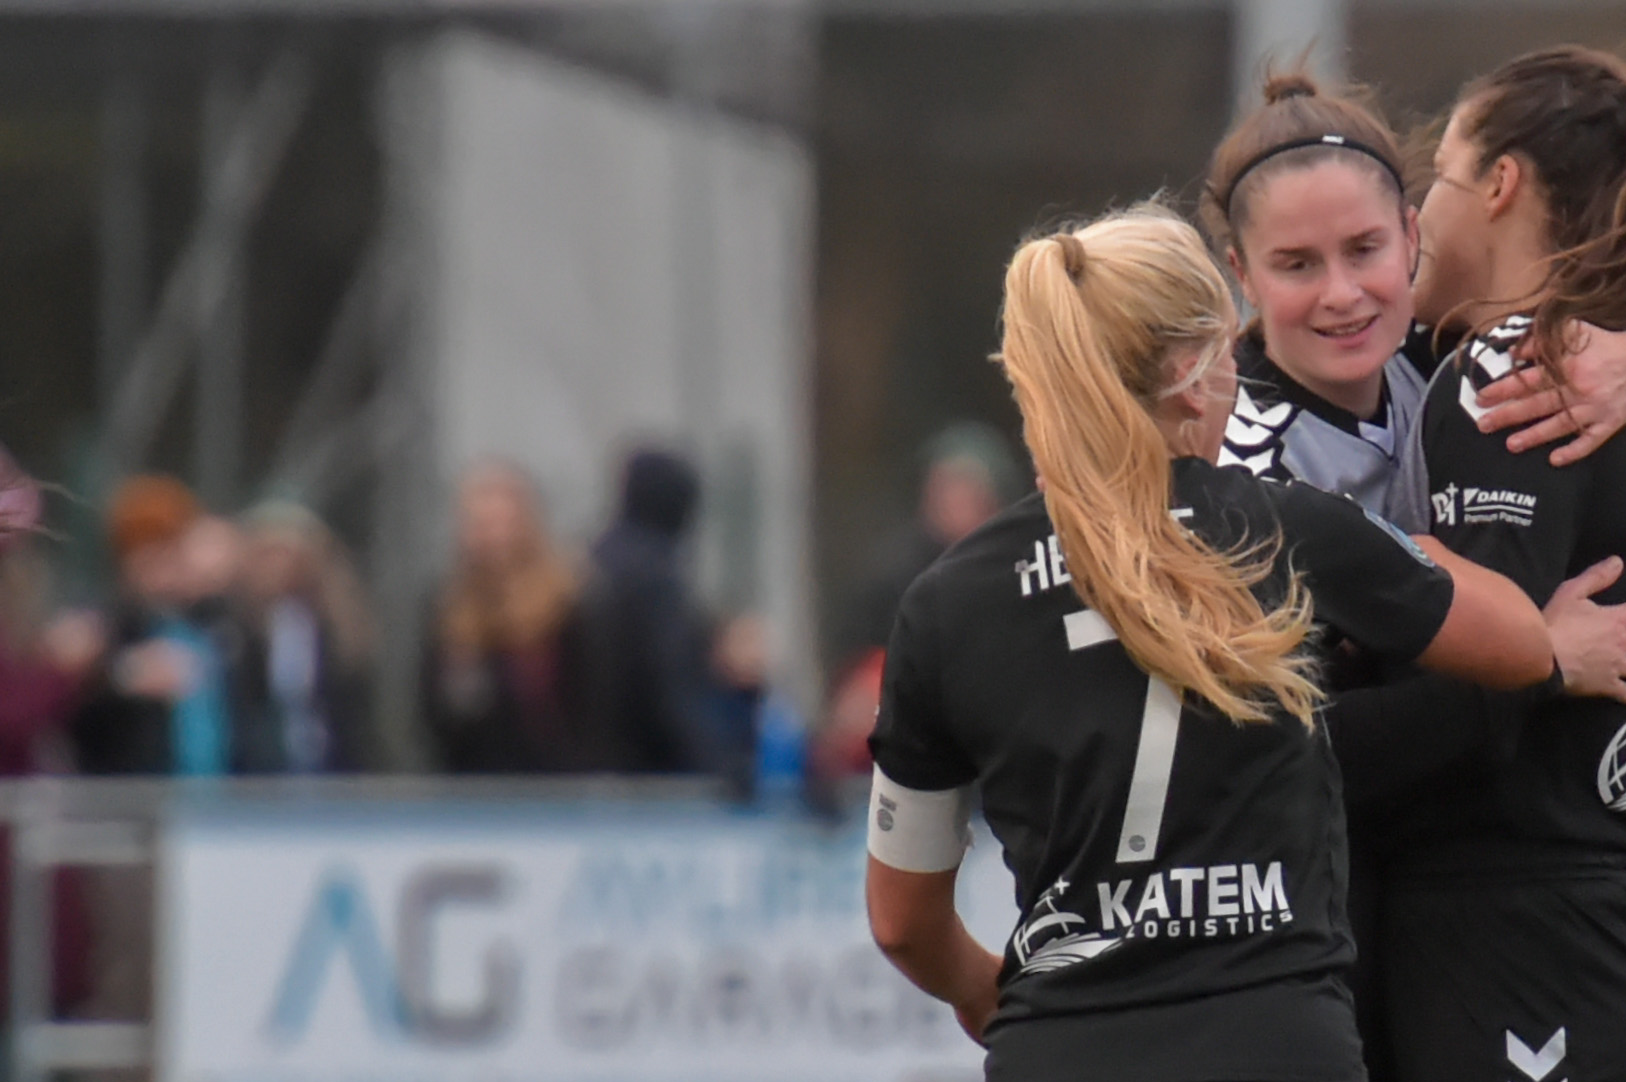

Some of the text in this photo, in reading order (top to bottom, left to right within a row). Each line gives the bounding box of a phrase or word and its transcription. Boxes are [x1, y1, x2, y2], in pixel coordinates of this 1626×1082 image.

[1477, 490, 1536, 507] DAIKIN
[1097, 861, 1289, 931] KATEM
[1125, 909, 1293, 939] LOGISTICS
